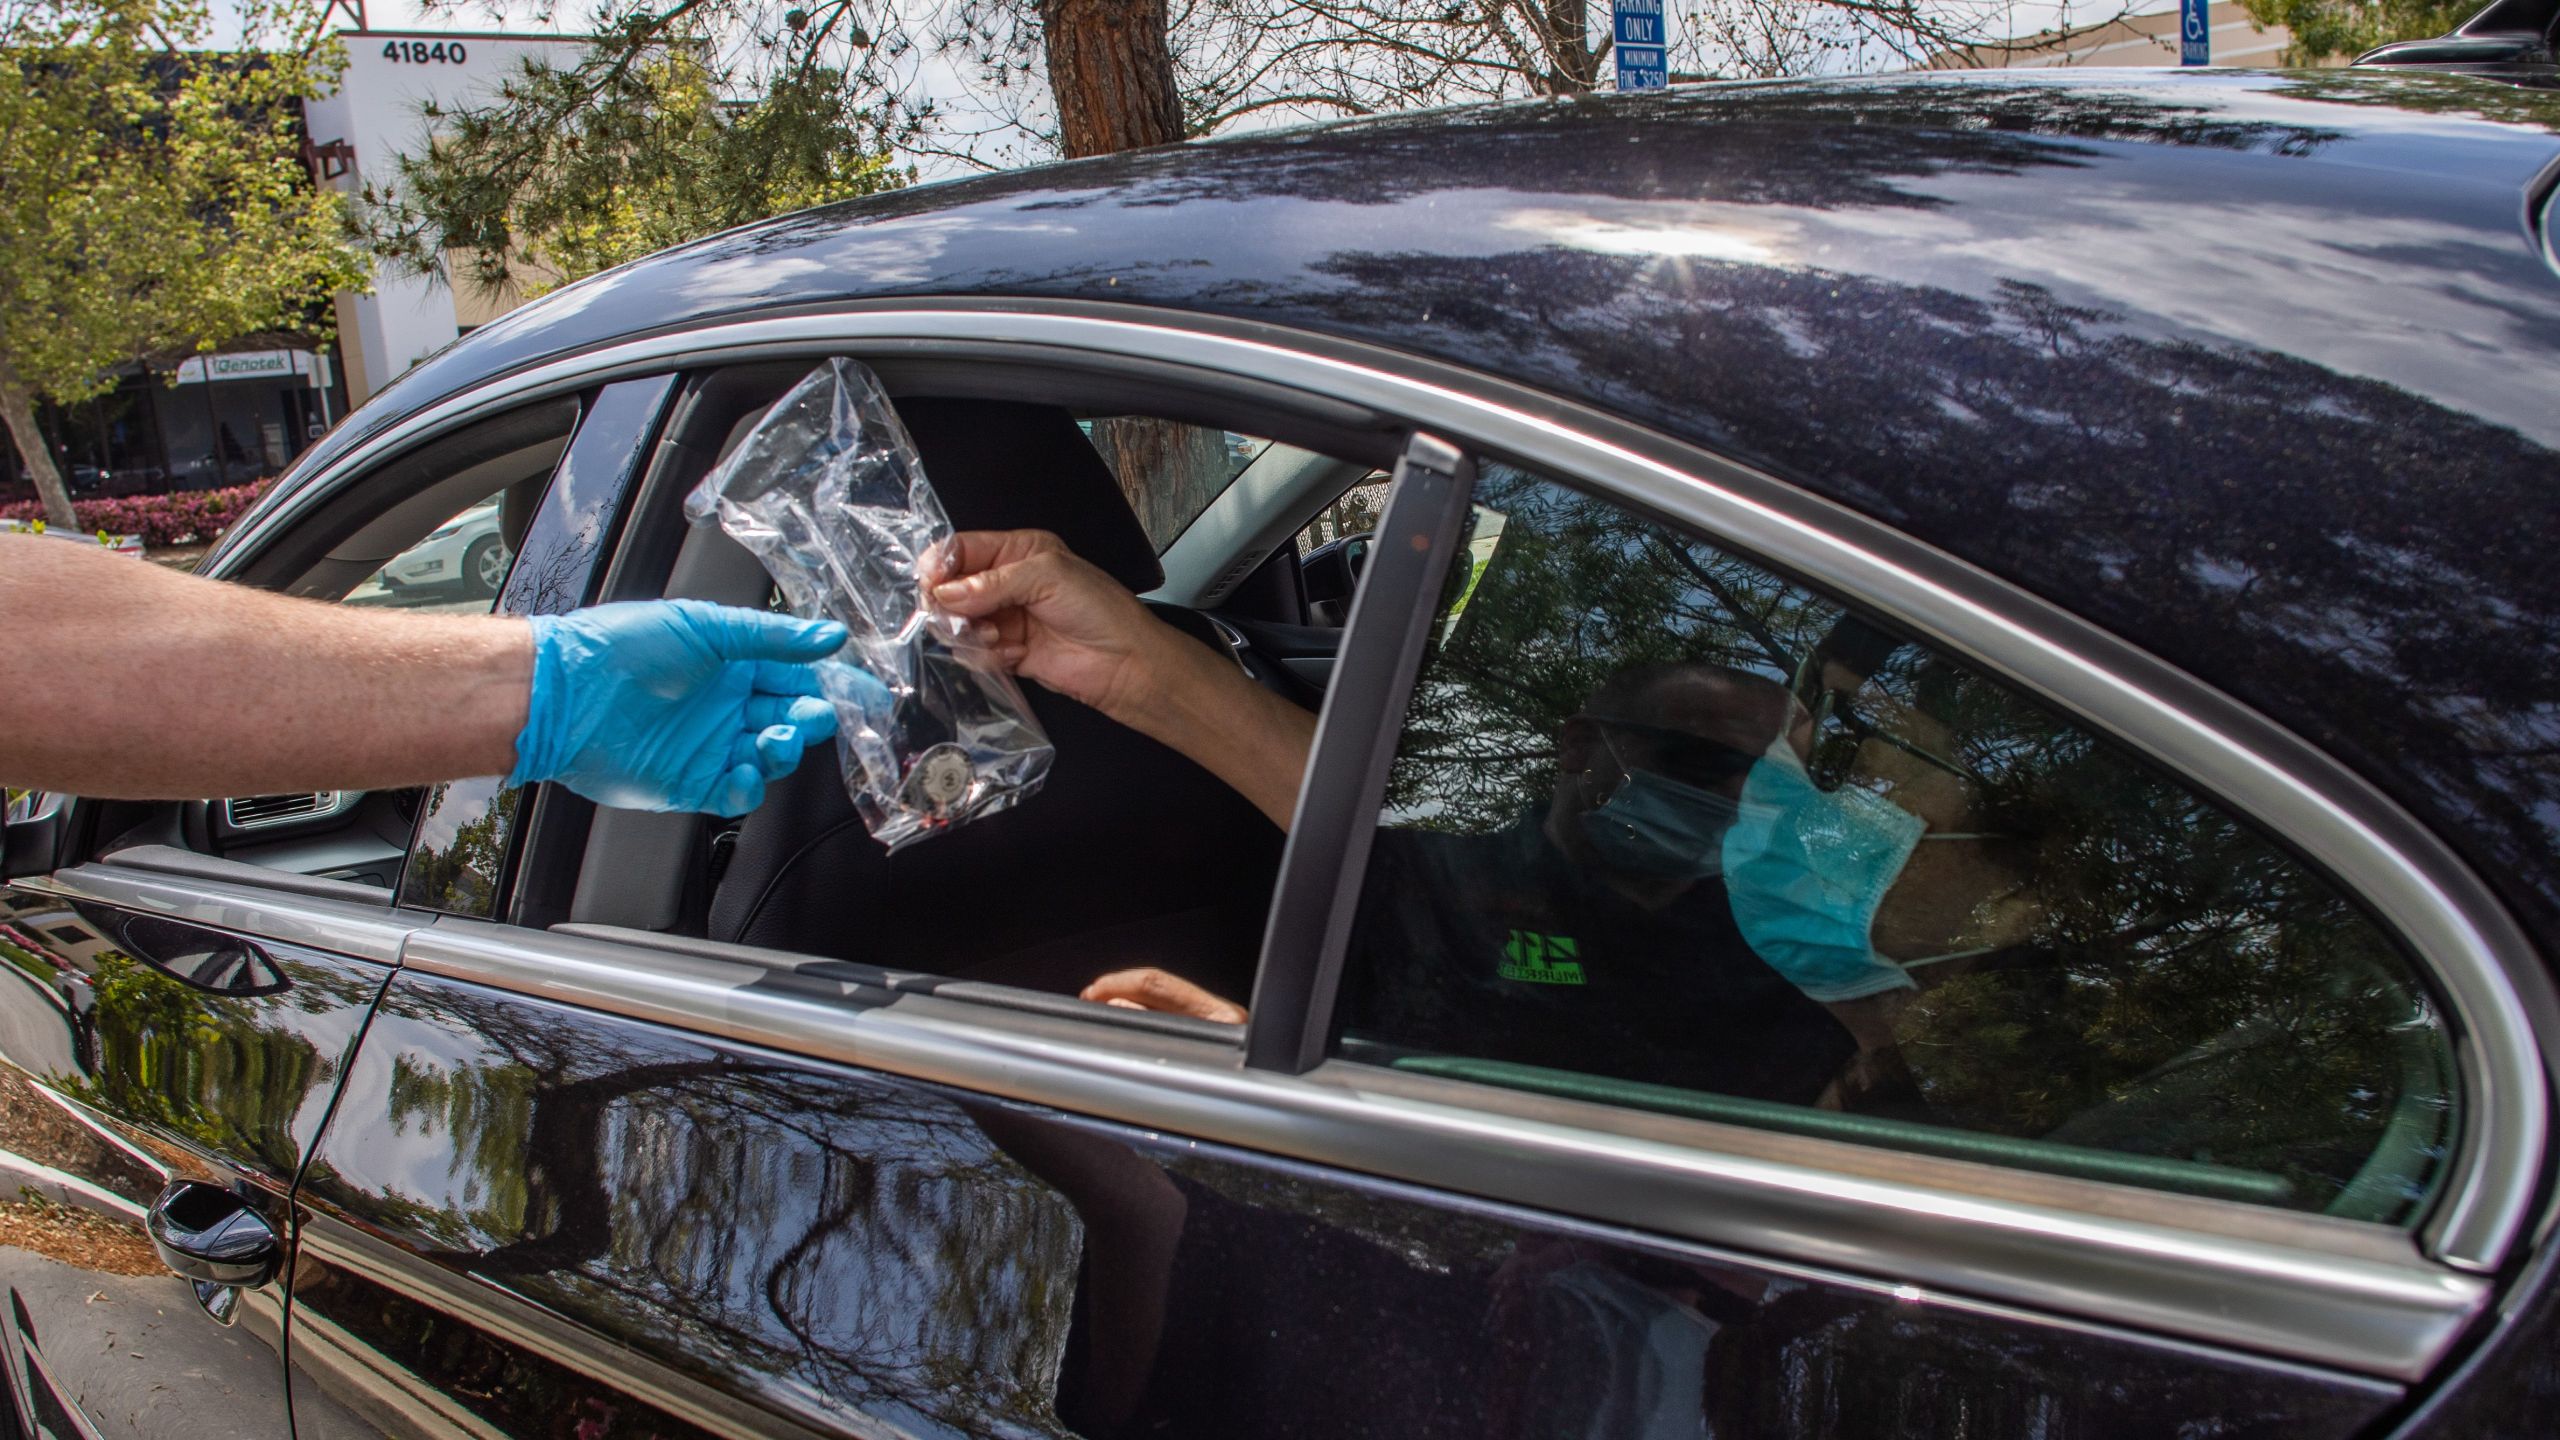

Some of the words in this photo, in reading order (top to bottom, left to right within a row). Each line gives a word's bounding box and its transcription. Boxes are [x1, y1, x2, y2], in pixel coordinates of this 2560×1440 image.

[1614, 0, 1661, 15] PARKING
[1625, 17, 1653, 41] ONLY
[383, 40, 467, 65] 41840
[1624, 50, 1658, 67] MINIMUM
[1620, 70, 1637, 88] FINE
[1642, 71, 1665, 88] $250
